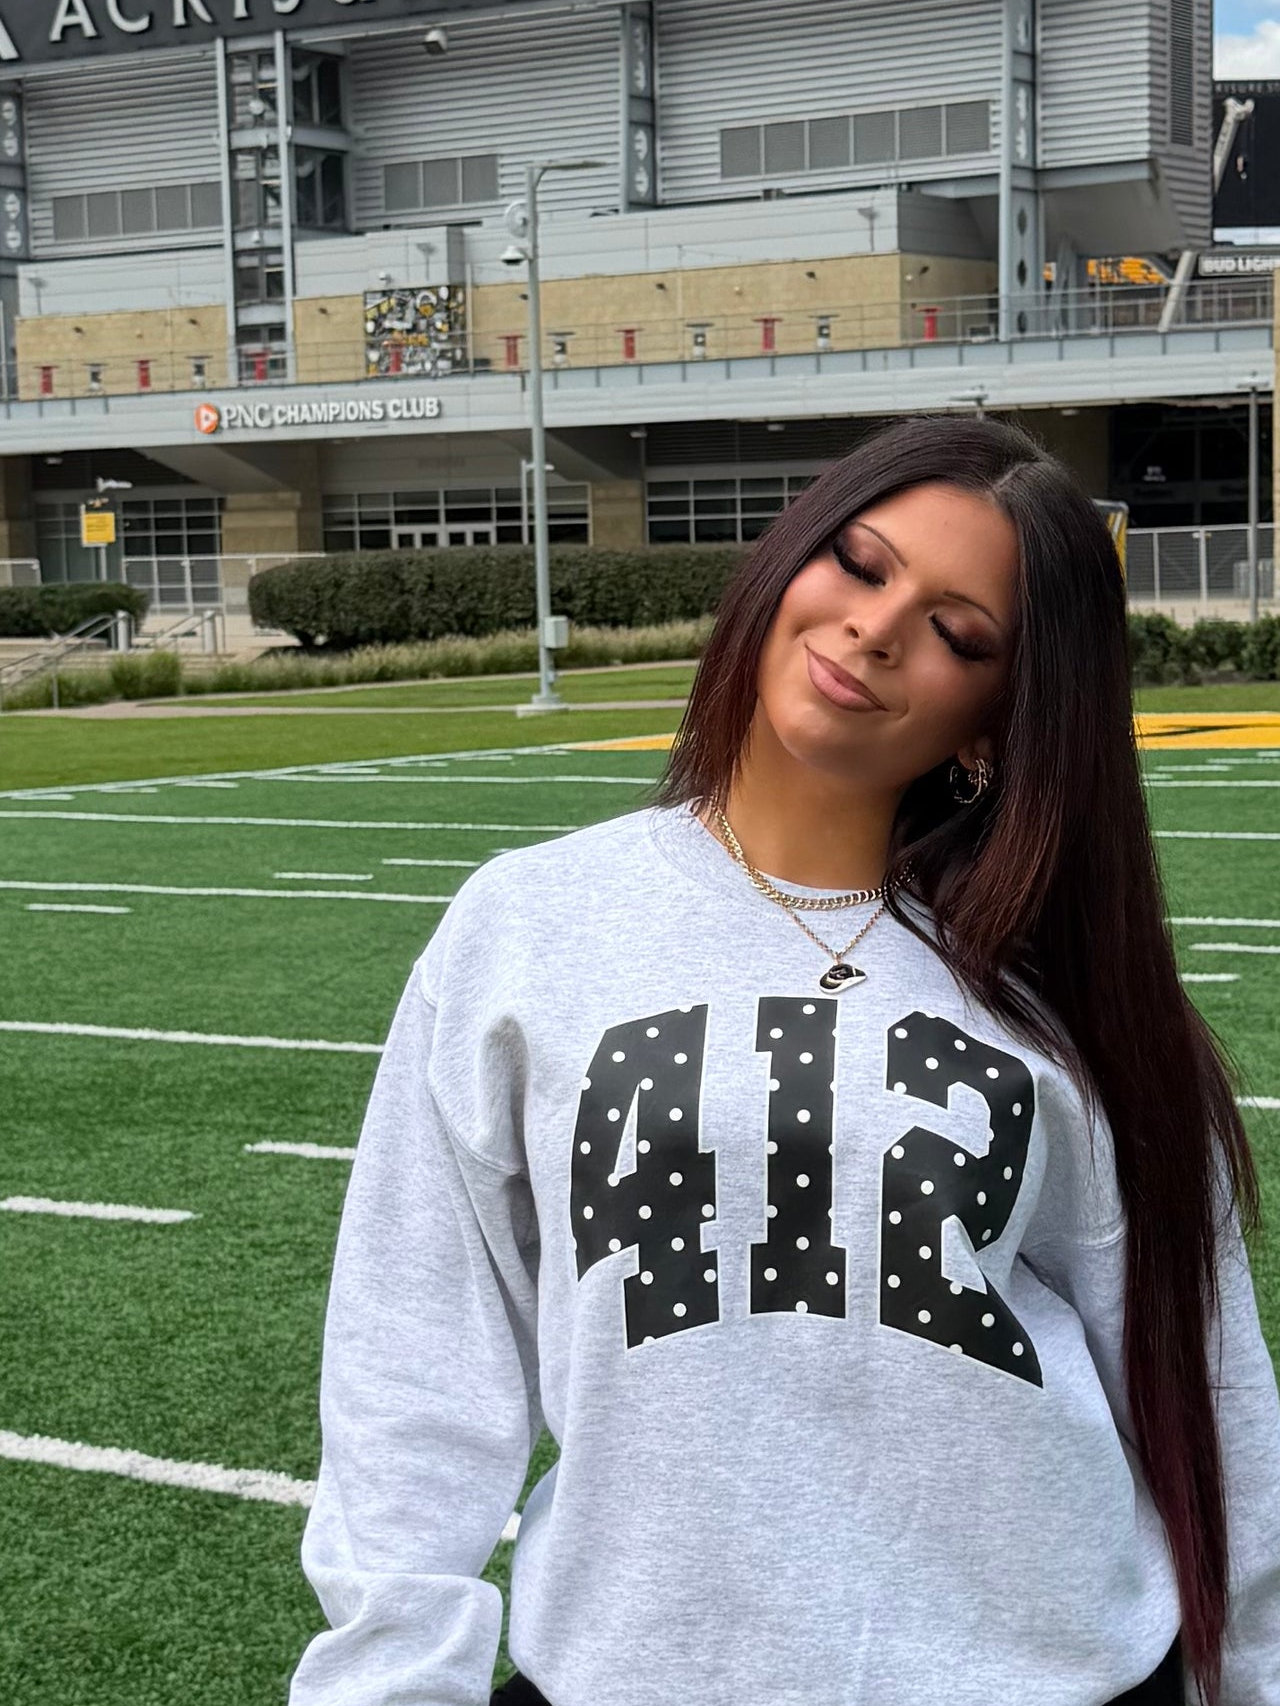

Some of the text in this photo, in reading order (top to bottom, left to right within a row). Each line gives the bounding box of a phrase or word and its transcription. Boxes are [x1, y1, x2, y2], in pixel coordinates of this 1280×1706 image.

[221, 397, 440, 429] PNC CHAMPIONS CLUB
[569, 995, 1045, 1390] 412
